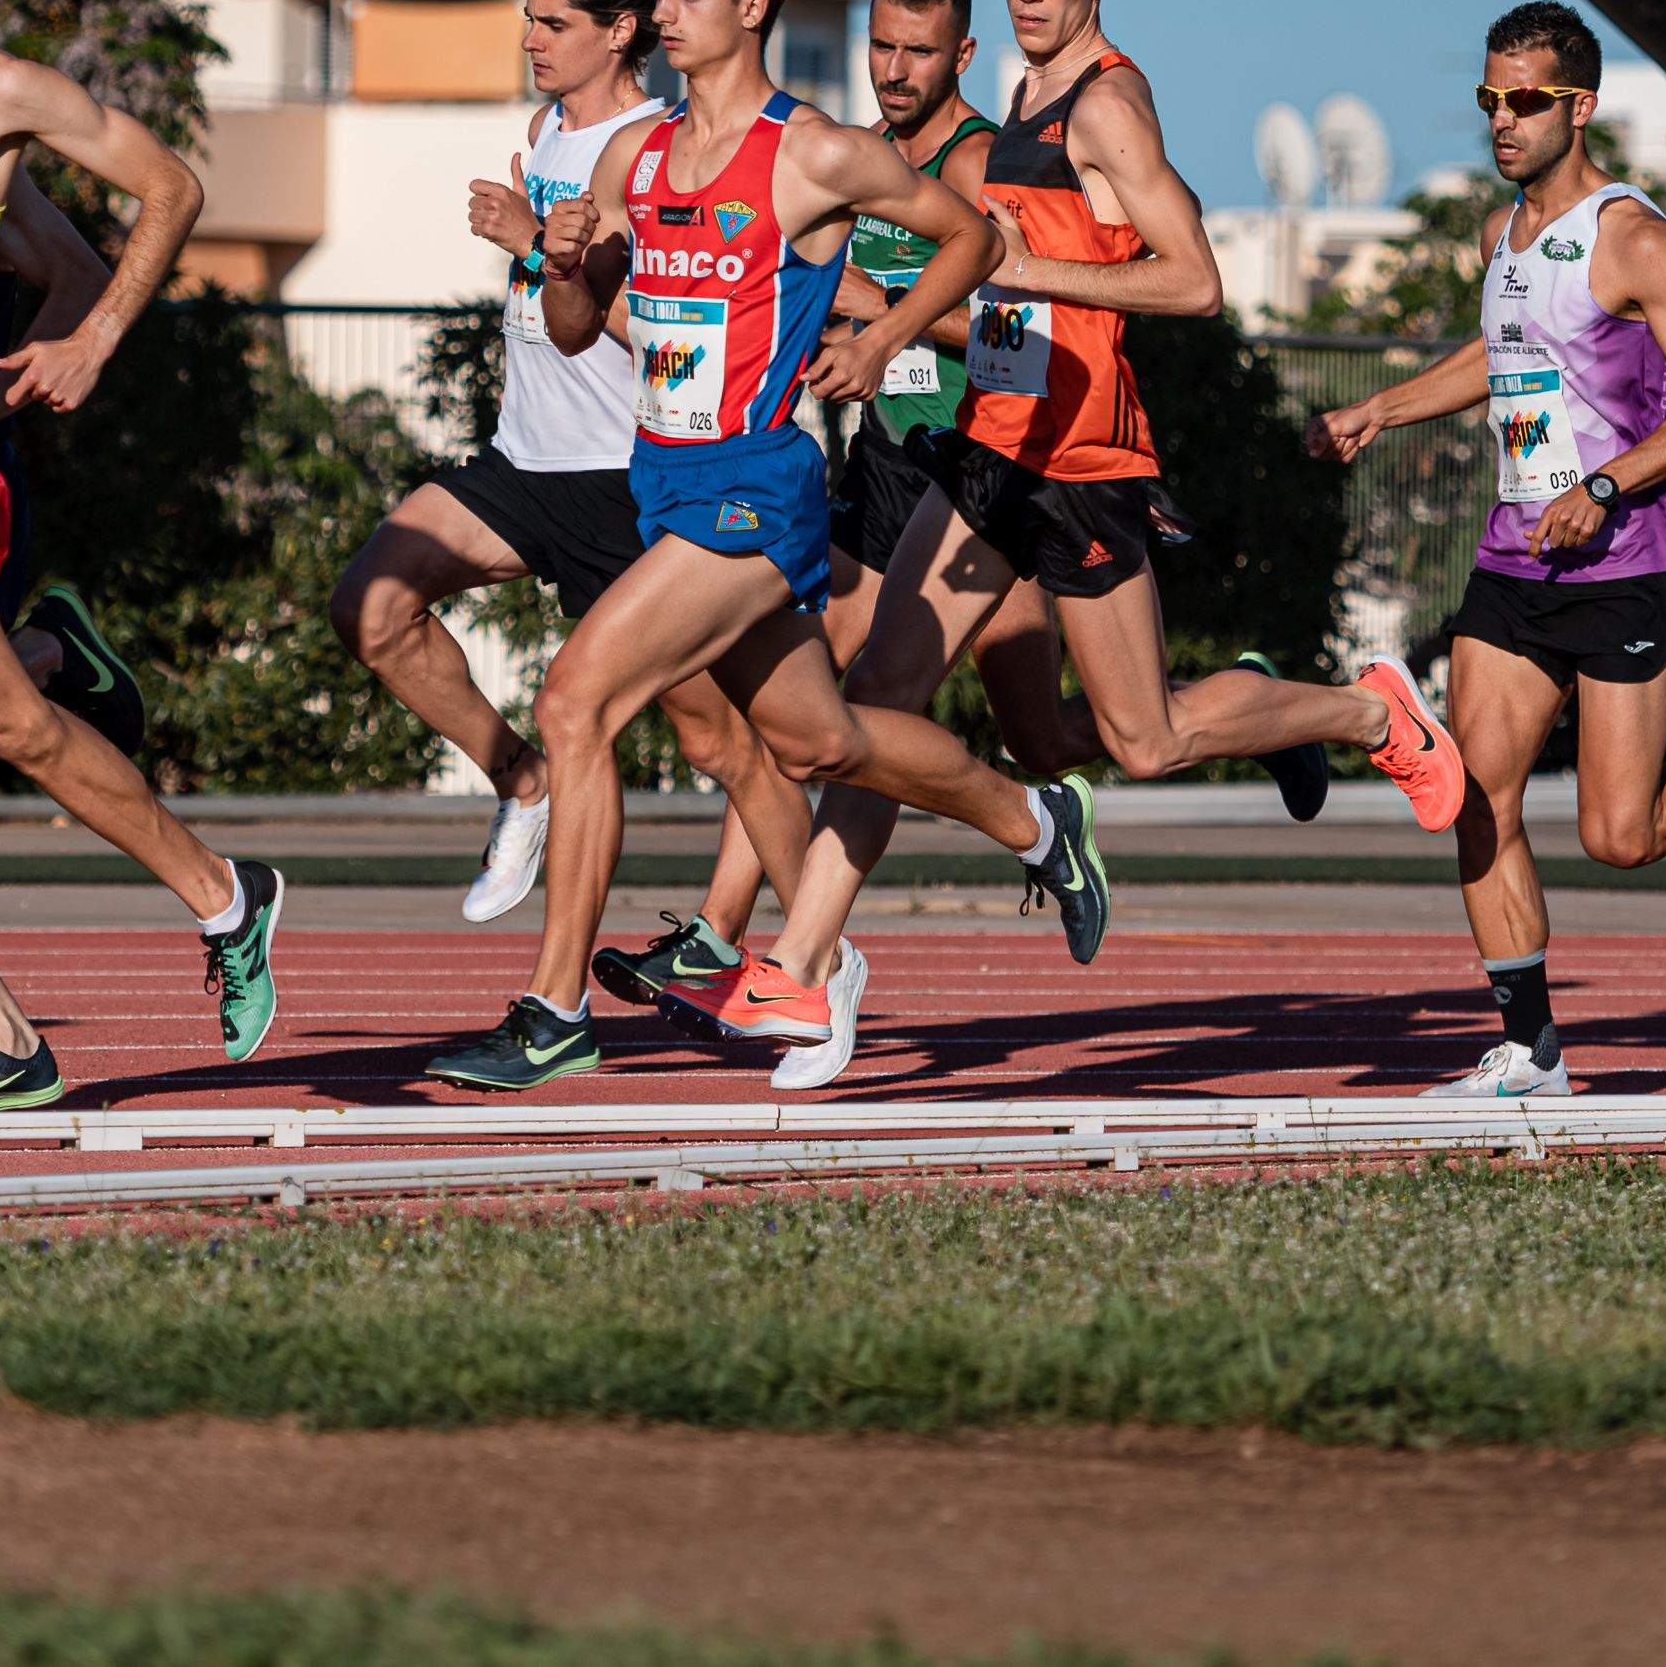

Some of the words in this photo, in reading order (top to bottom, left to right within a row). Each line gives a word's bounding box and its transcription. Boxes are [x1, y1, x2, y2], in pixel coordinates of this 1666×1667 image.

[1038, 133, 1064, 145] adidas
[556, 180, 582, 196] ONE
[909, 368, 931, 385] 031
[689, 411, 713, 431] 026
[1549, 470, 1579, 490] 030
